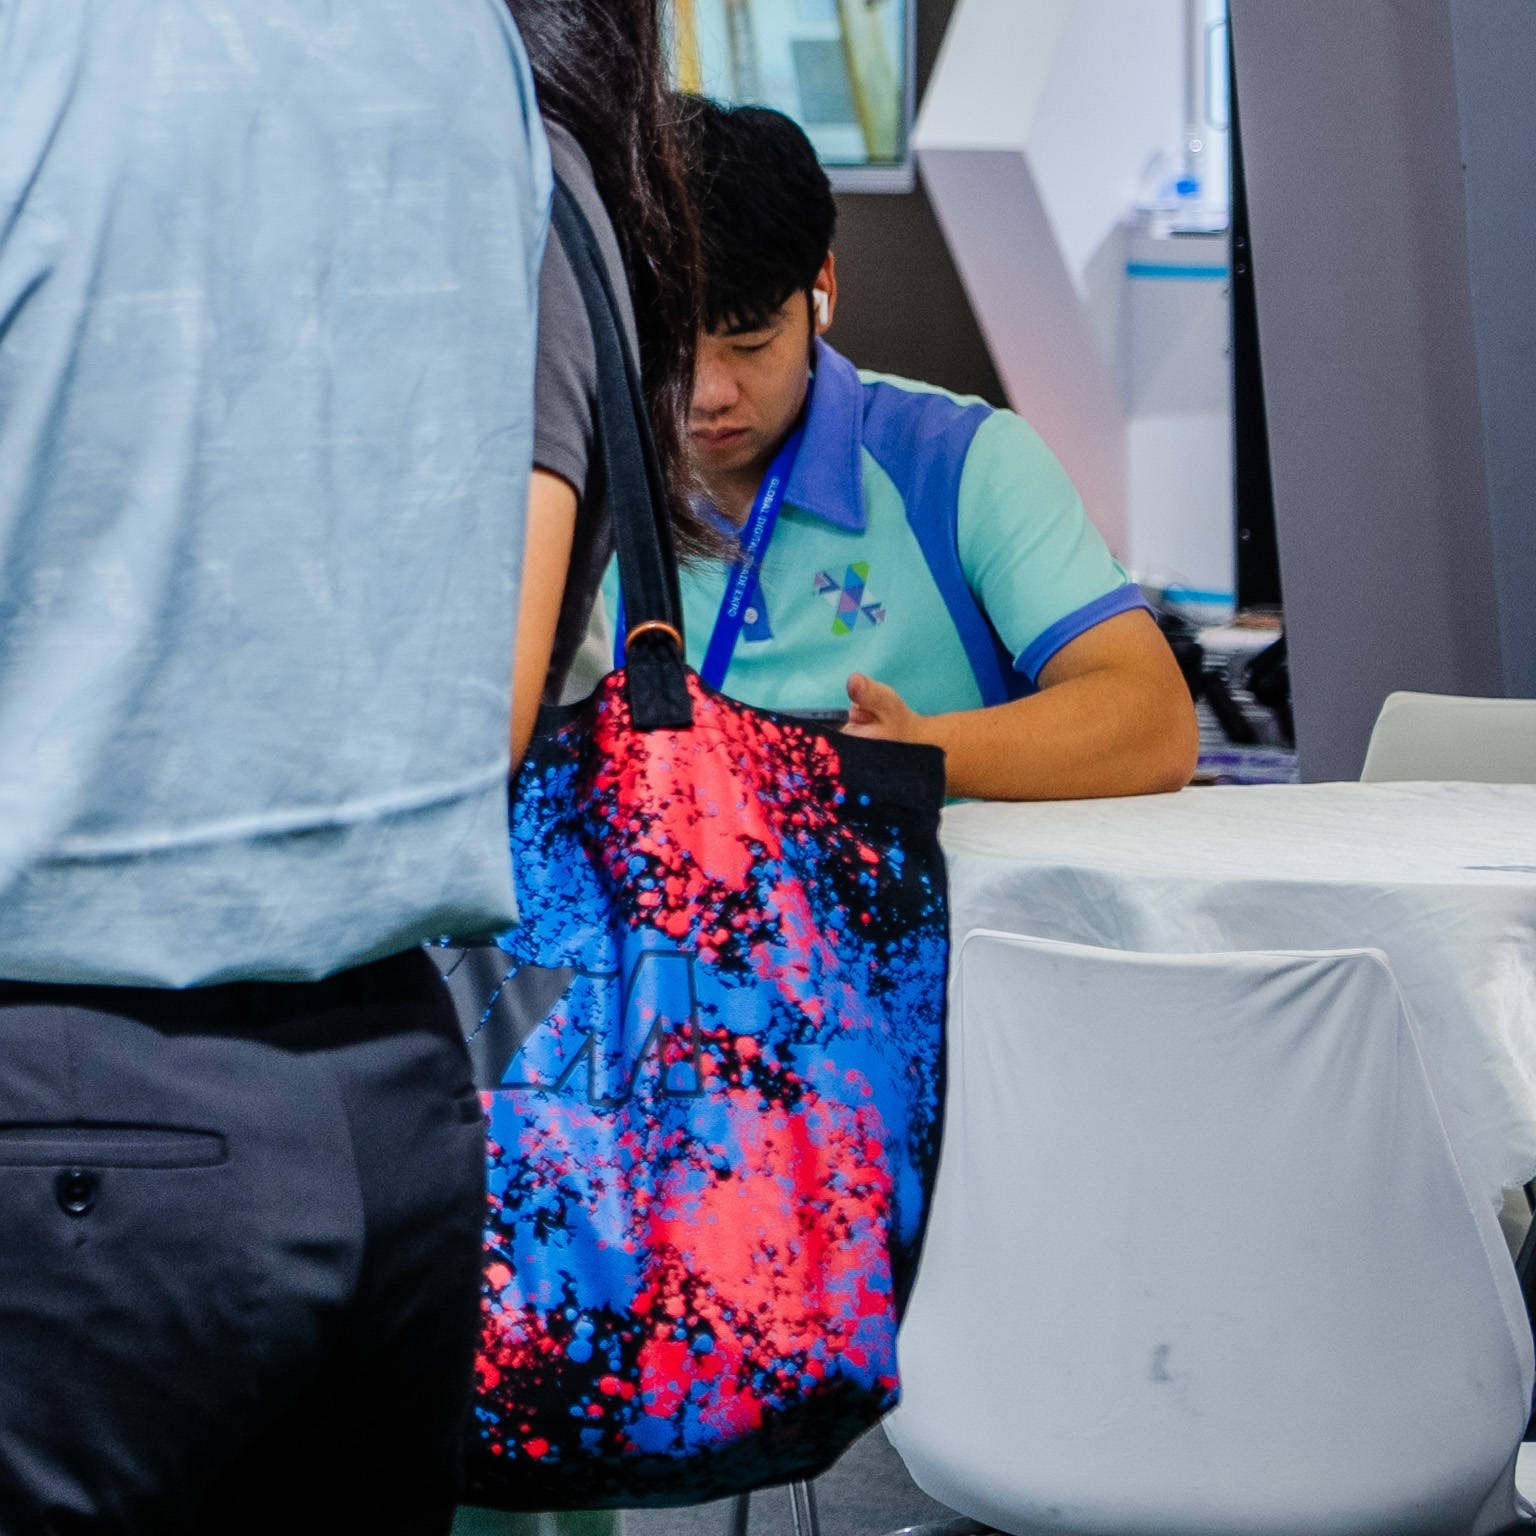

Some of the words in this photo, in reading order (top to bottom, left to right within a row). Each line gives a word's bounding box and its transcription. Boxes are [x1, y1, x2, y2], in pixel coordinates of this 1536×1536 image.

[760, 477, 780, 514] GLOBAL
[748, 517, 767, 554] DIGITAL
[728, 589, 742, 617] EXPO
